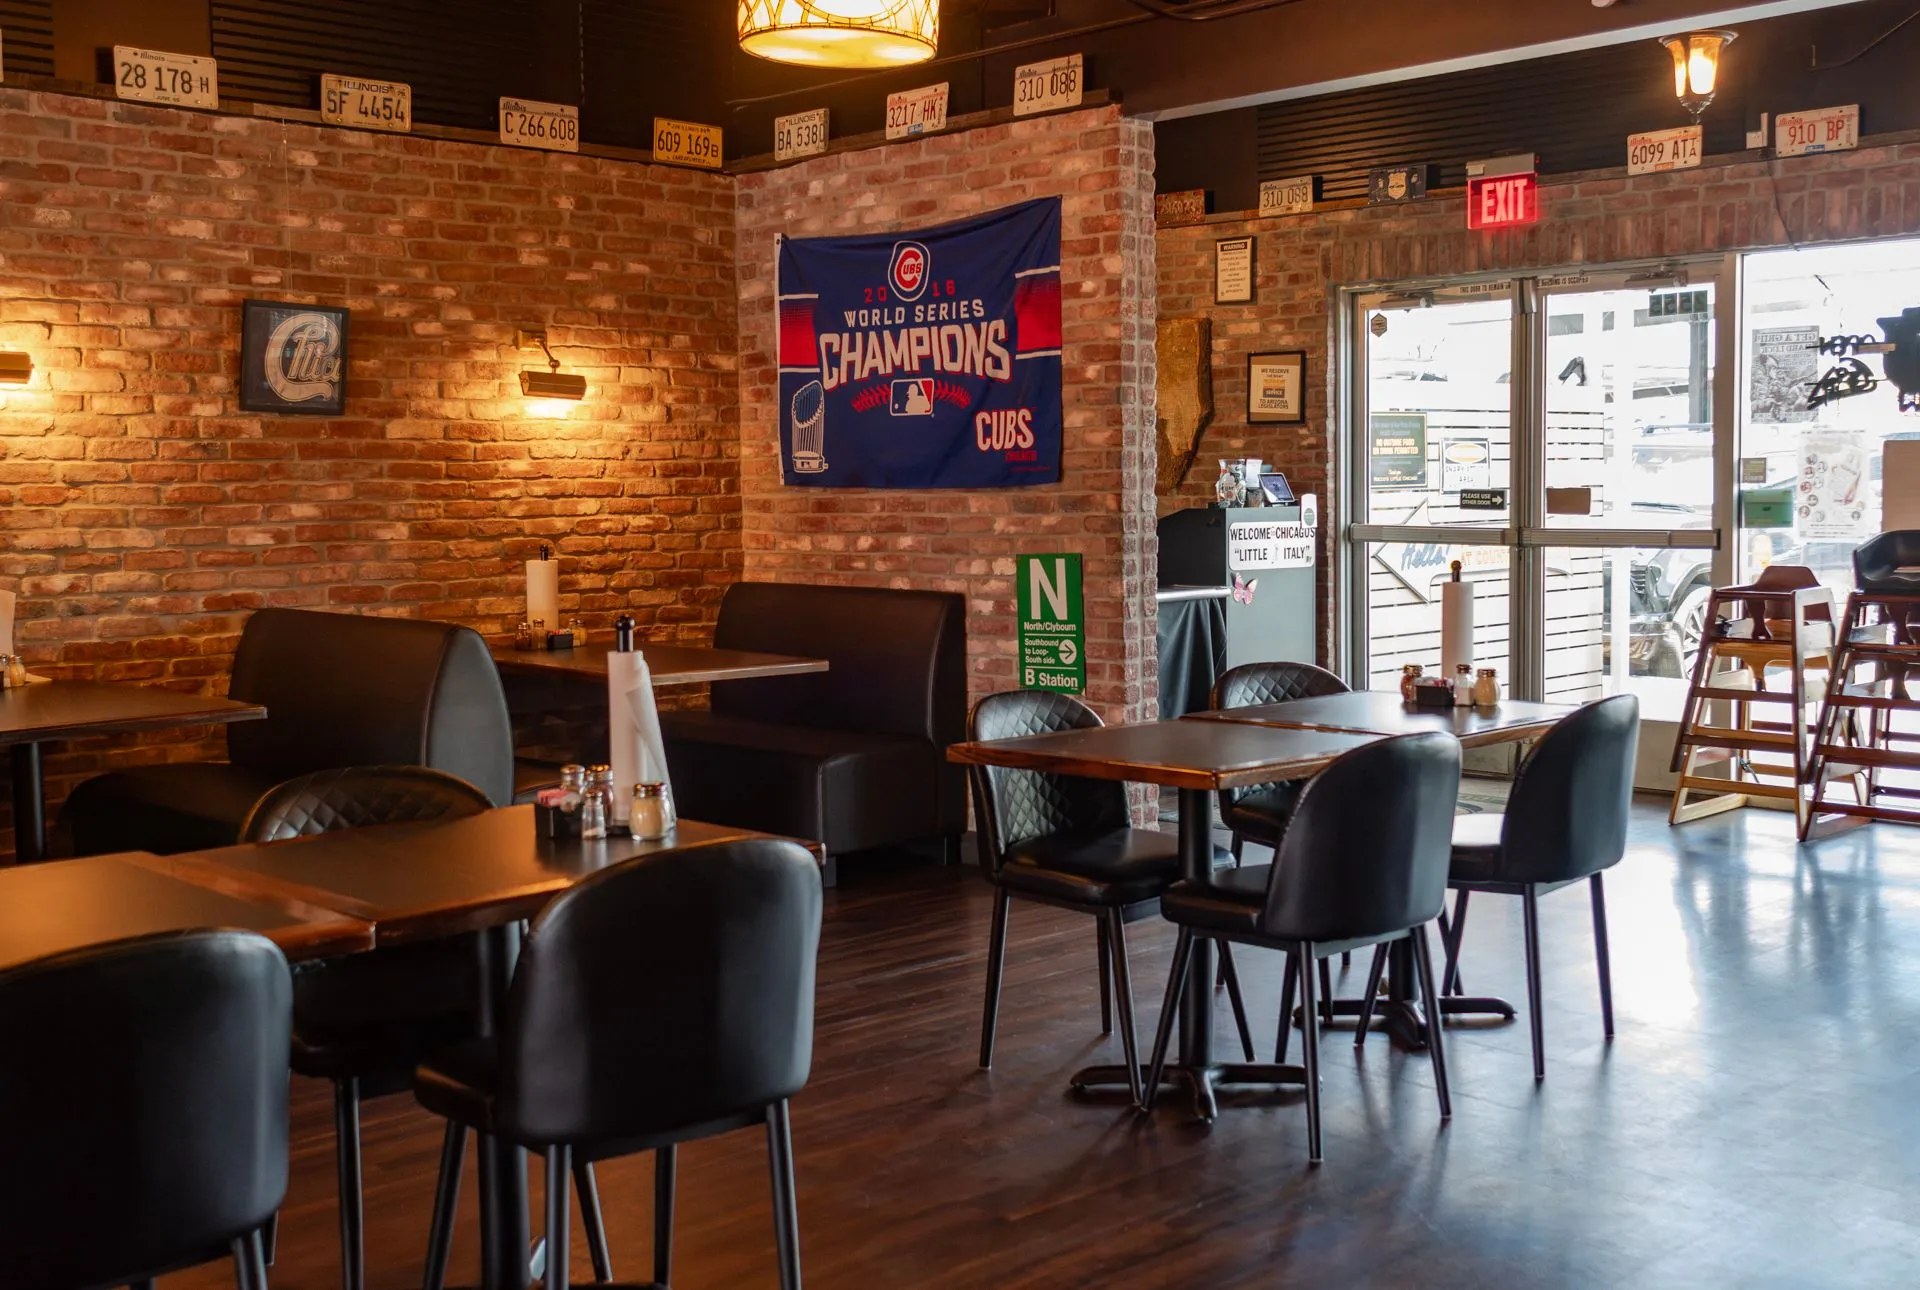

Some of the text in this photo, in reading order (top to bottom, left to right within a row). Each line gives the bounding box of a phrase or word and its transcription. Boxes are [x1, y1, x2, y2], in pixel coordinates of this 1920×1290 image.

[140, 52, 165, 61] Illinois
[121, 62, 209, 94] 28 178 H
[344, 80, 389, 93] ILLINOIS
[1018, 70, 1076, 102] 310 088
[327, 90, 405, 122] SF 4454
[889, 103, 916, 128] 3217
[922, 98, 938, 122] HK
[505, 112, 575, 141] C 266 608
[778, 123, 825, 151] BA 5380
[1788, 124, 1816, 146] 910
[1826, 120, 1845, 142] BP
[658, 130, 718, 158] 609 169 B
[1632, 139, 1688, 165] 6099 AT
[1264, 190, 1282, 208] 310
[1482, 179, 1527, 224] EXIT
[864, 286, 887, 303] 20
[844, 299, 985, 328] WORLD SERIES
[819, 319, 1012, 391] CHAMPIONS
[975, 408, 1034, 452] CUBS
[1230, 528, 1271, 541] WELCOME
[1276, 527, 1315, 539] CHICAGOS
[1029, 558, 1068, 620] N
[1024, 622, 1076, 631] North/Clybourn
[1025, 638, 1059, 647] Southbound
[1025, 669, 1078, 688] B Station
